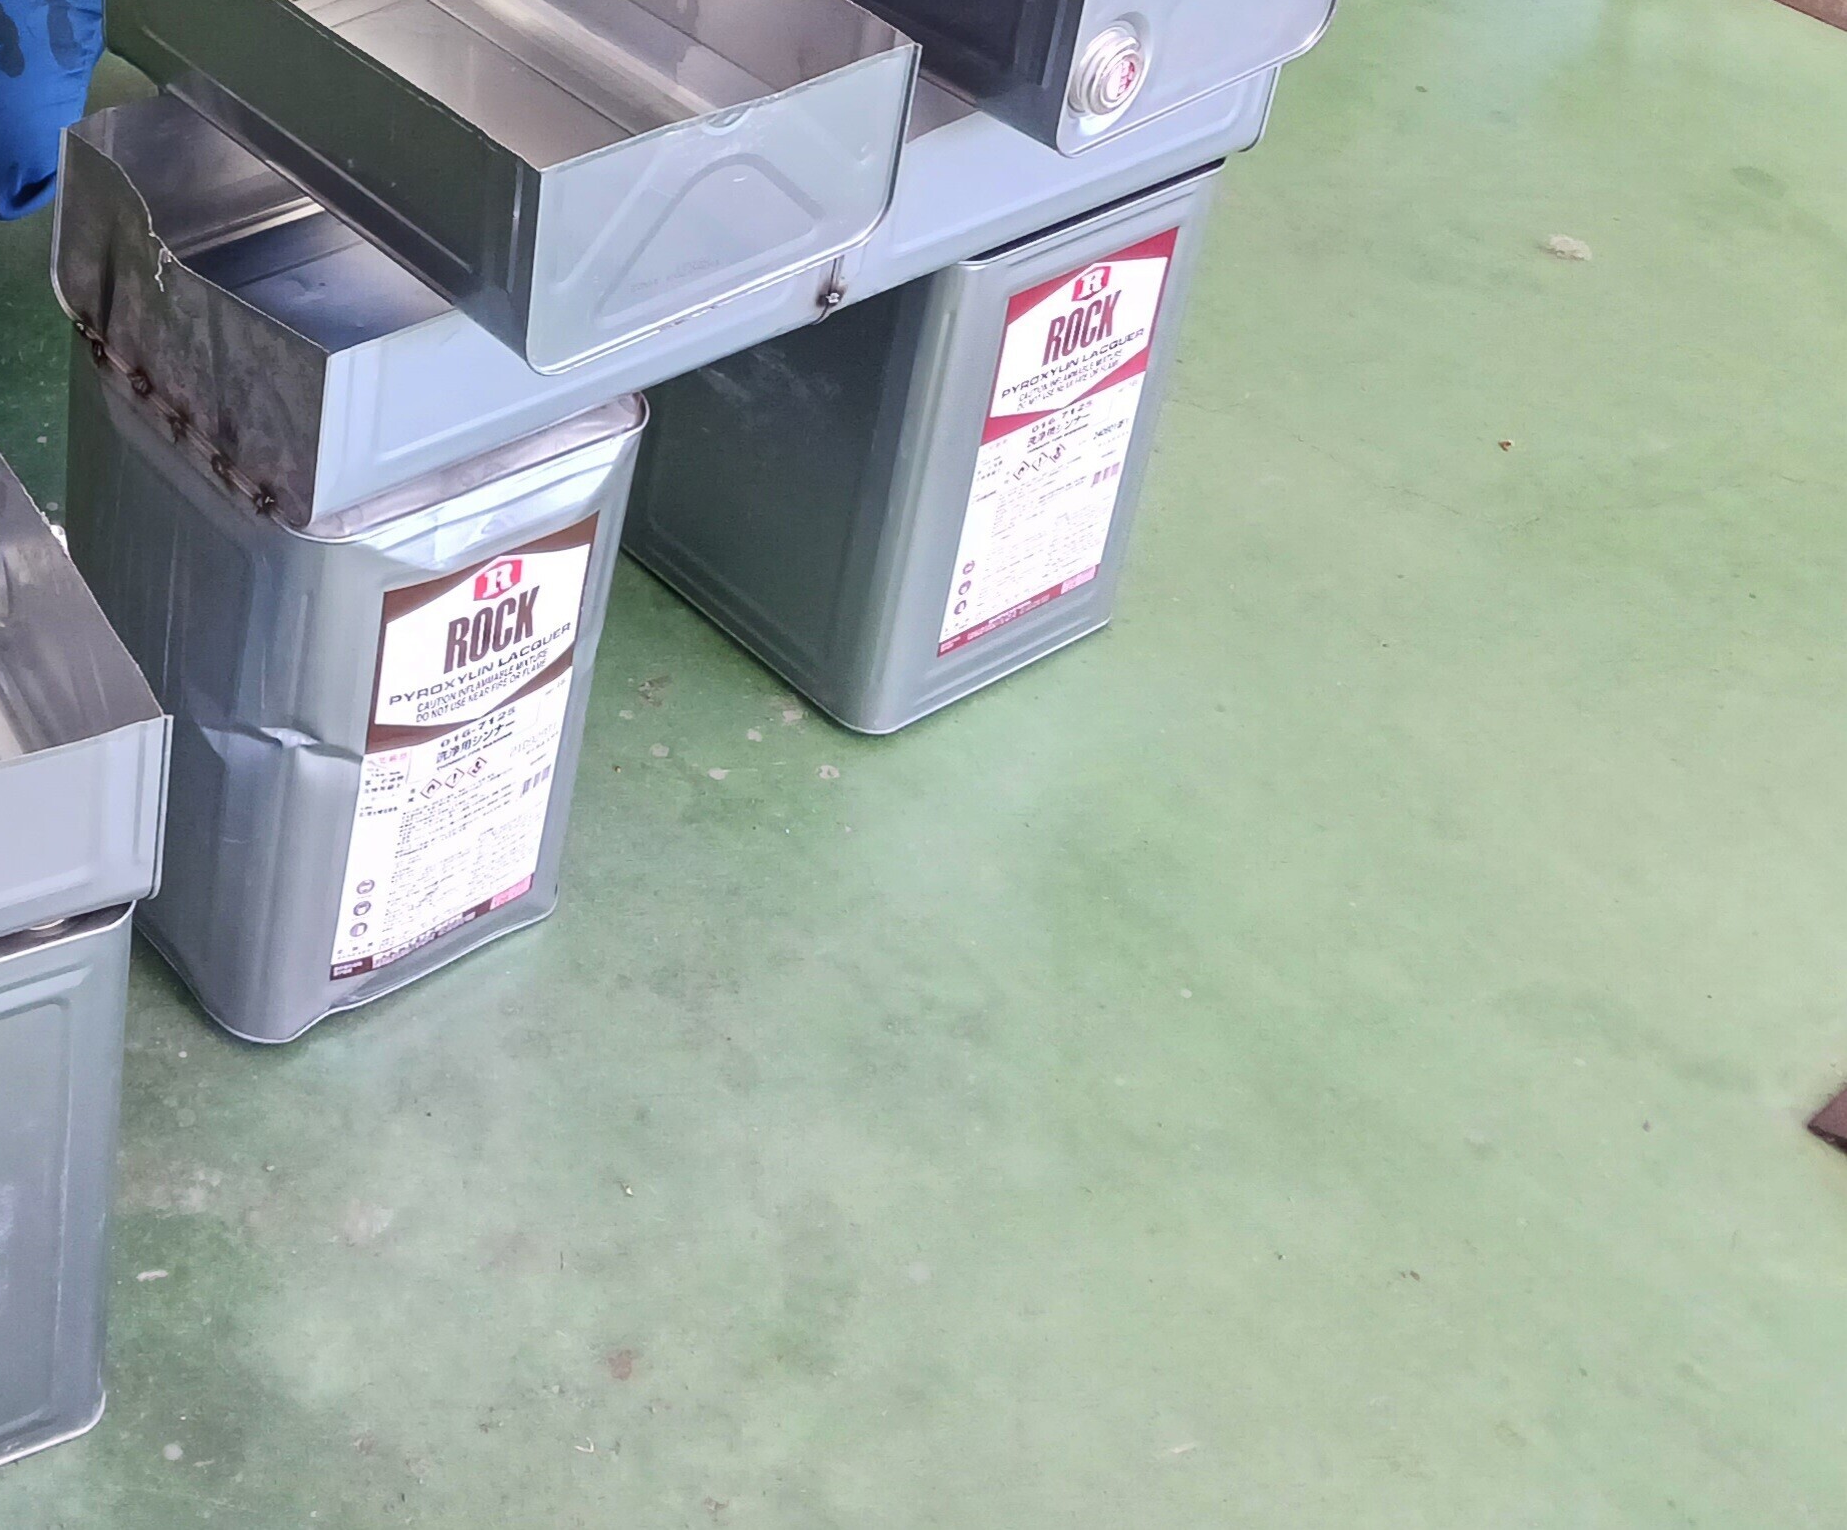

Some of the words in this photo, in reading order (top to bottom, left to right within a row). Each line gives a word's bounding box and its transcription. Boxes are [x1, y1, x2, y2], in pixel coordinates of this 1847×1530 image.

[1041, 290, 1122, 367] ROCK
[1001, 358, 1080, 399] PYROXYLIN
[1082, 328, 1145, 363] LACQUER
[1031, 400, 1093, 434] 0167125
[443, 585, 541, 675] ROCK
[389, 662, 494, 706] PYROXYLIN
[498, 622, 572, 666] LACQUER
[415, 711, 429, 723] DO
[430, 704, 449, 718] NOT
[450, 698, 466, 711] USE
[468, 688, 489, 703] NEAR
[491, 681, 508, 693] FIRE
[522, 659, 547, 678] FLAME
[416, 692, 456, 713] CAUTION
[440, 706, 516, 748] 016-7125
[435, 719, 516, 764] 洗浄用シンナー
